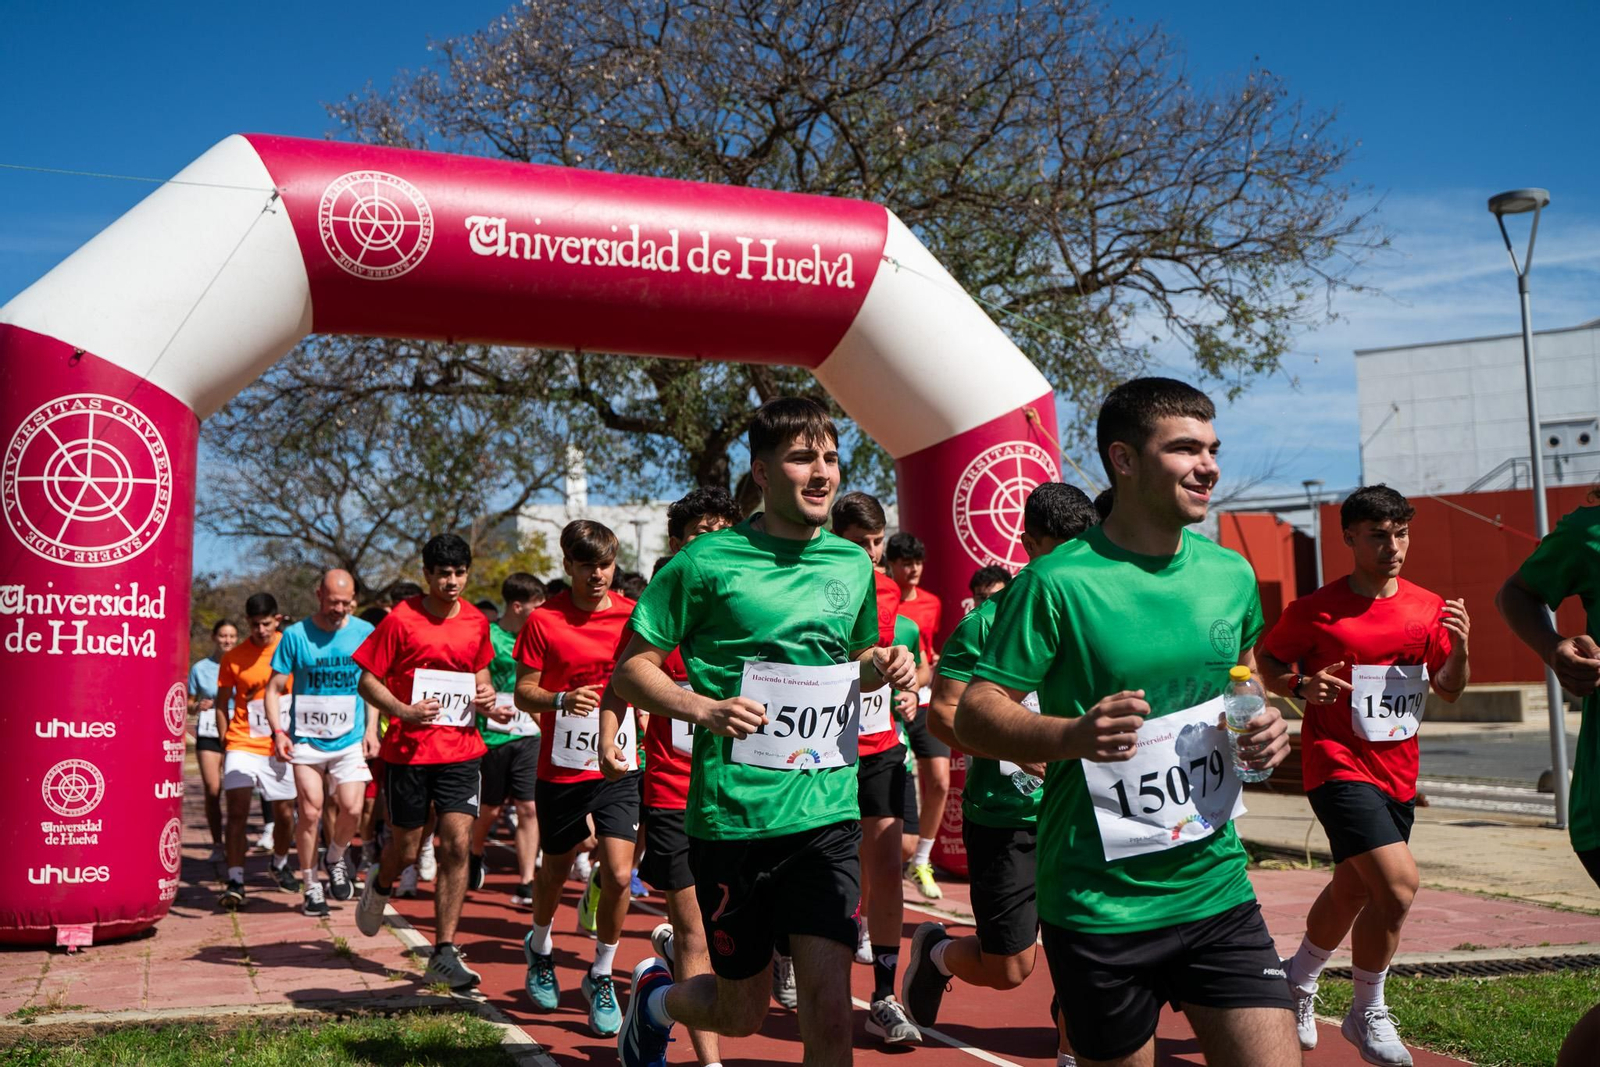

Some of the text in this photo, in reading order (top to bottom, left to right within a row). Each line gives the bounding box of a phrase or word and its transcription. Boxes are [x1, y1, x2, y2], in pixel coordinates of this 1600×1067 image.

[464, 214, 855, 289] Universidad de Huelva
[0, 581, 166, 620] Universidad
[5, 617, 157, 658] de Huelva
[752, 674, 782, 684] Haciendo
[1363, 691, 1423, 719] 15079
[35, 717, 117, 738] uhu.es
[303, 711, 347, 726] 15079
[563, 729, 628, 753] 1509
[1135, 732, 1175, 748] niversidad,
[1109, 749, 1225, 819] 15079
[40, 819, 103, 833] Universidad
[44, 833, 99, 846] de Huelva
[28, 863, 111, 885] uhu.es
